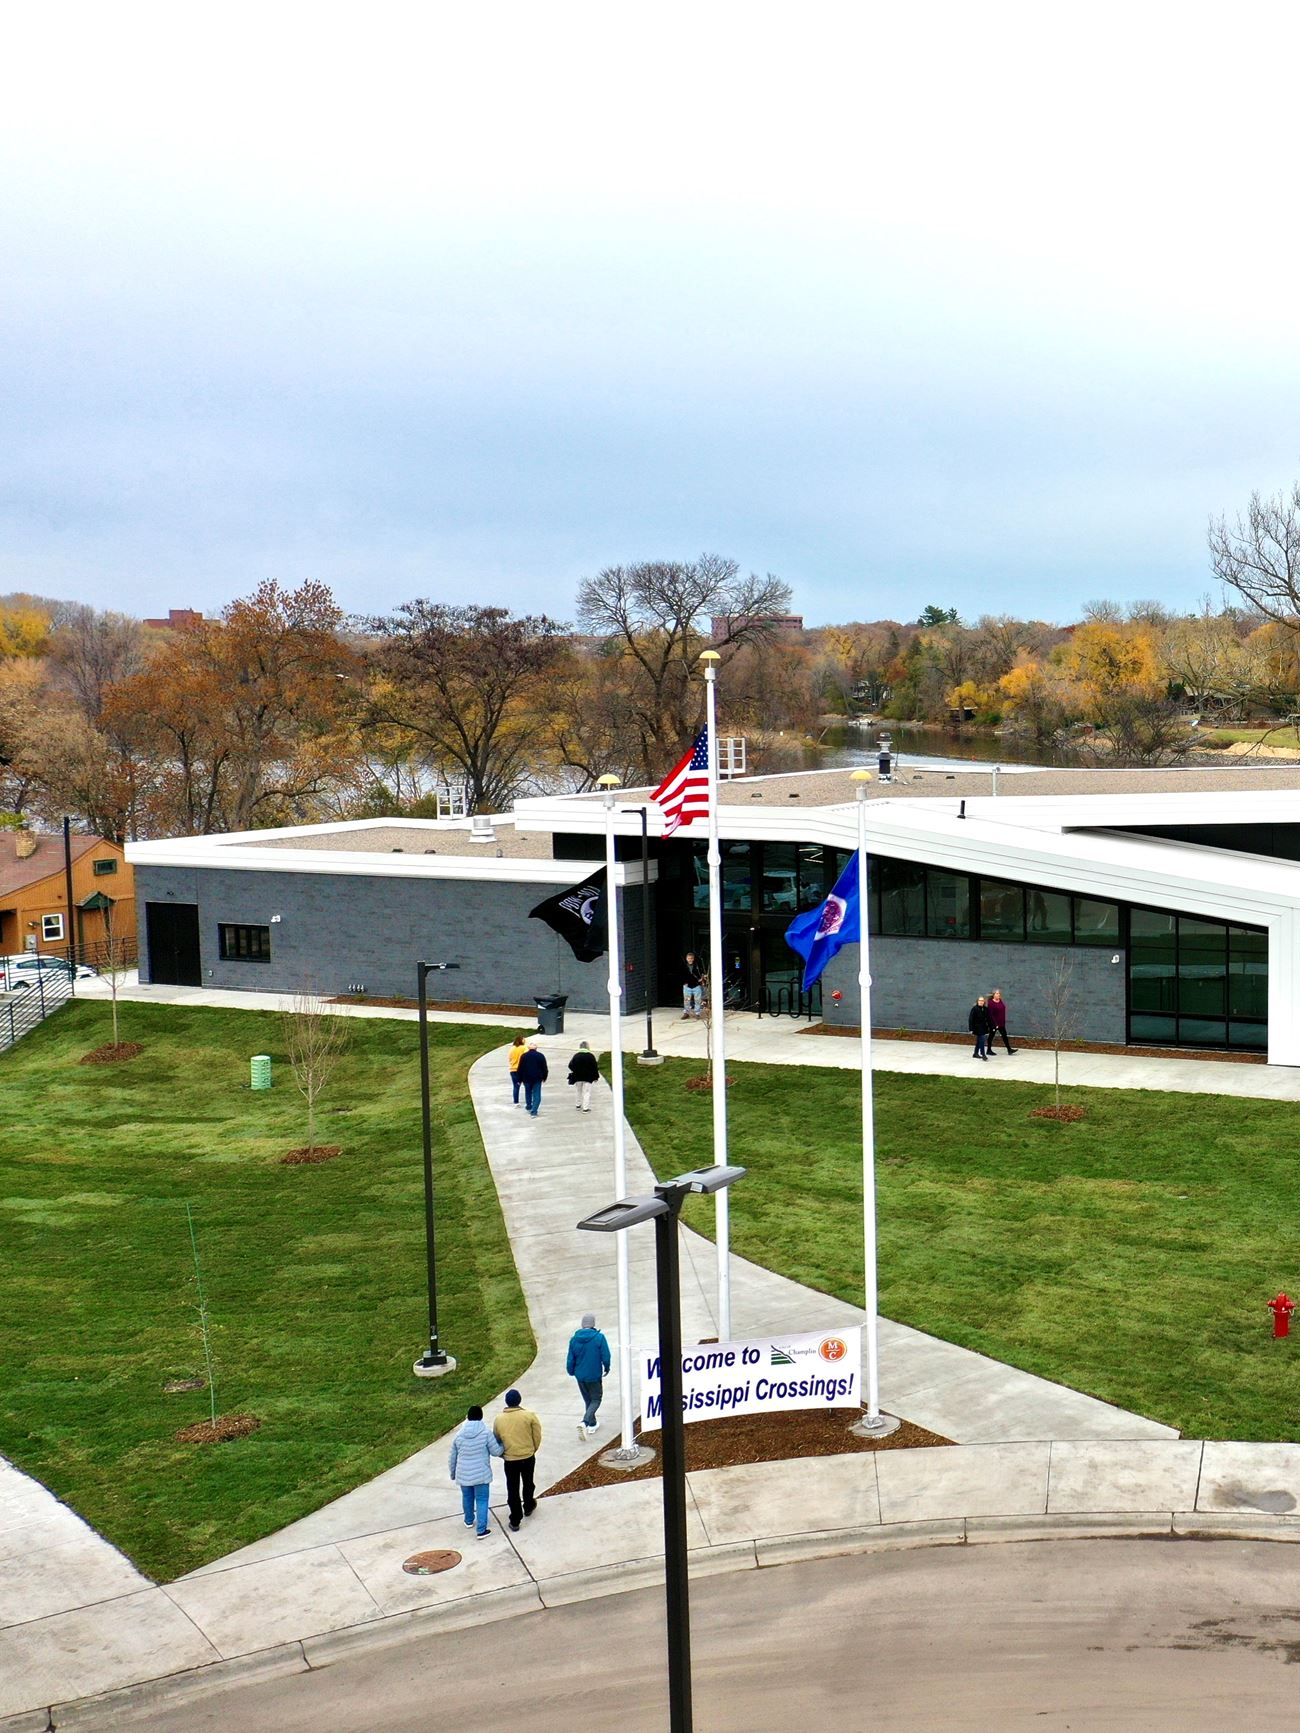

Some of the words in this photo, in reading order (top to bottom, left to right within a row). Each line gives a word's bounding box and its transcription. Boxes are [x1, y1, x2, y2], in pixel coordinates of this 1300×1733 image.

[827, 1341, 839, 1350] M
[828, 1351, 837, 1360] C
[647, 1351, 735, 1380] Wcome
[742, 1346, 761, 1365] to
[647, 1380, 750, 1418] Msissippi
[755, 1373, 854, 1401] Crossings!
